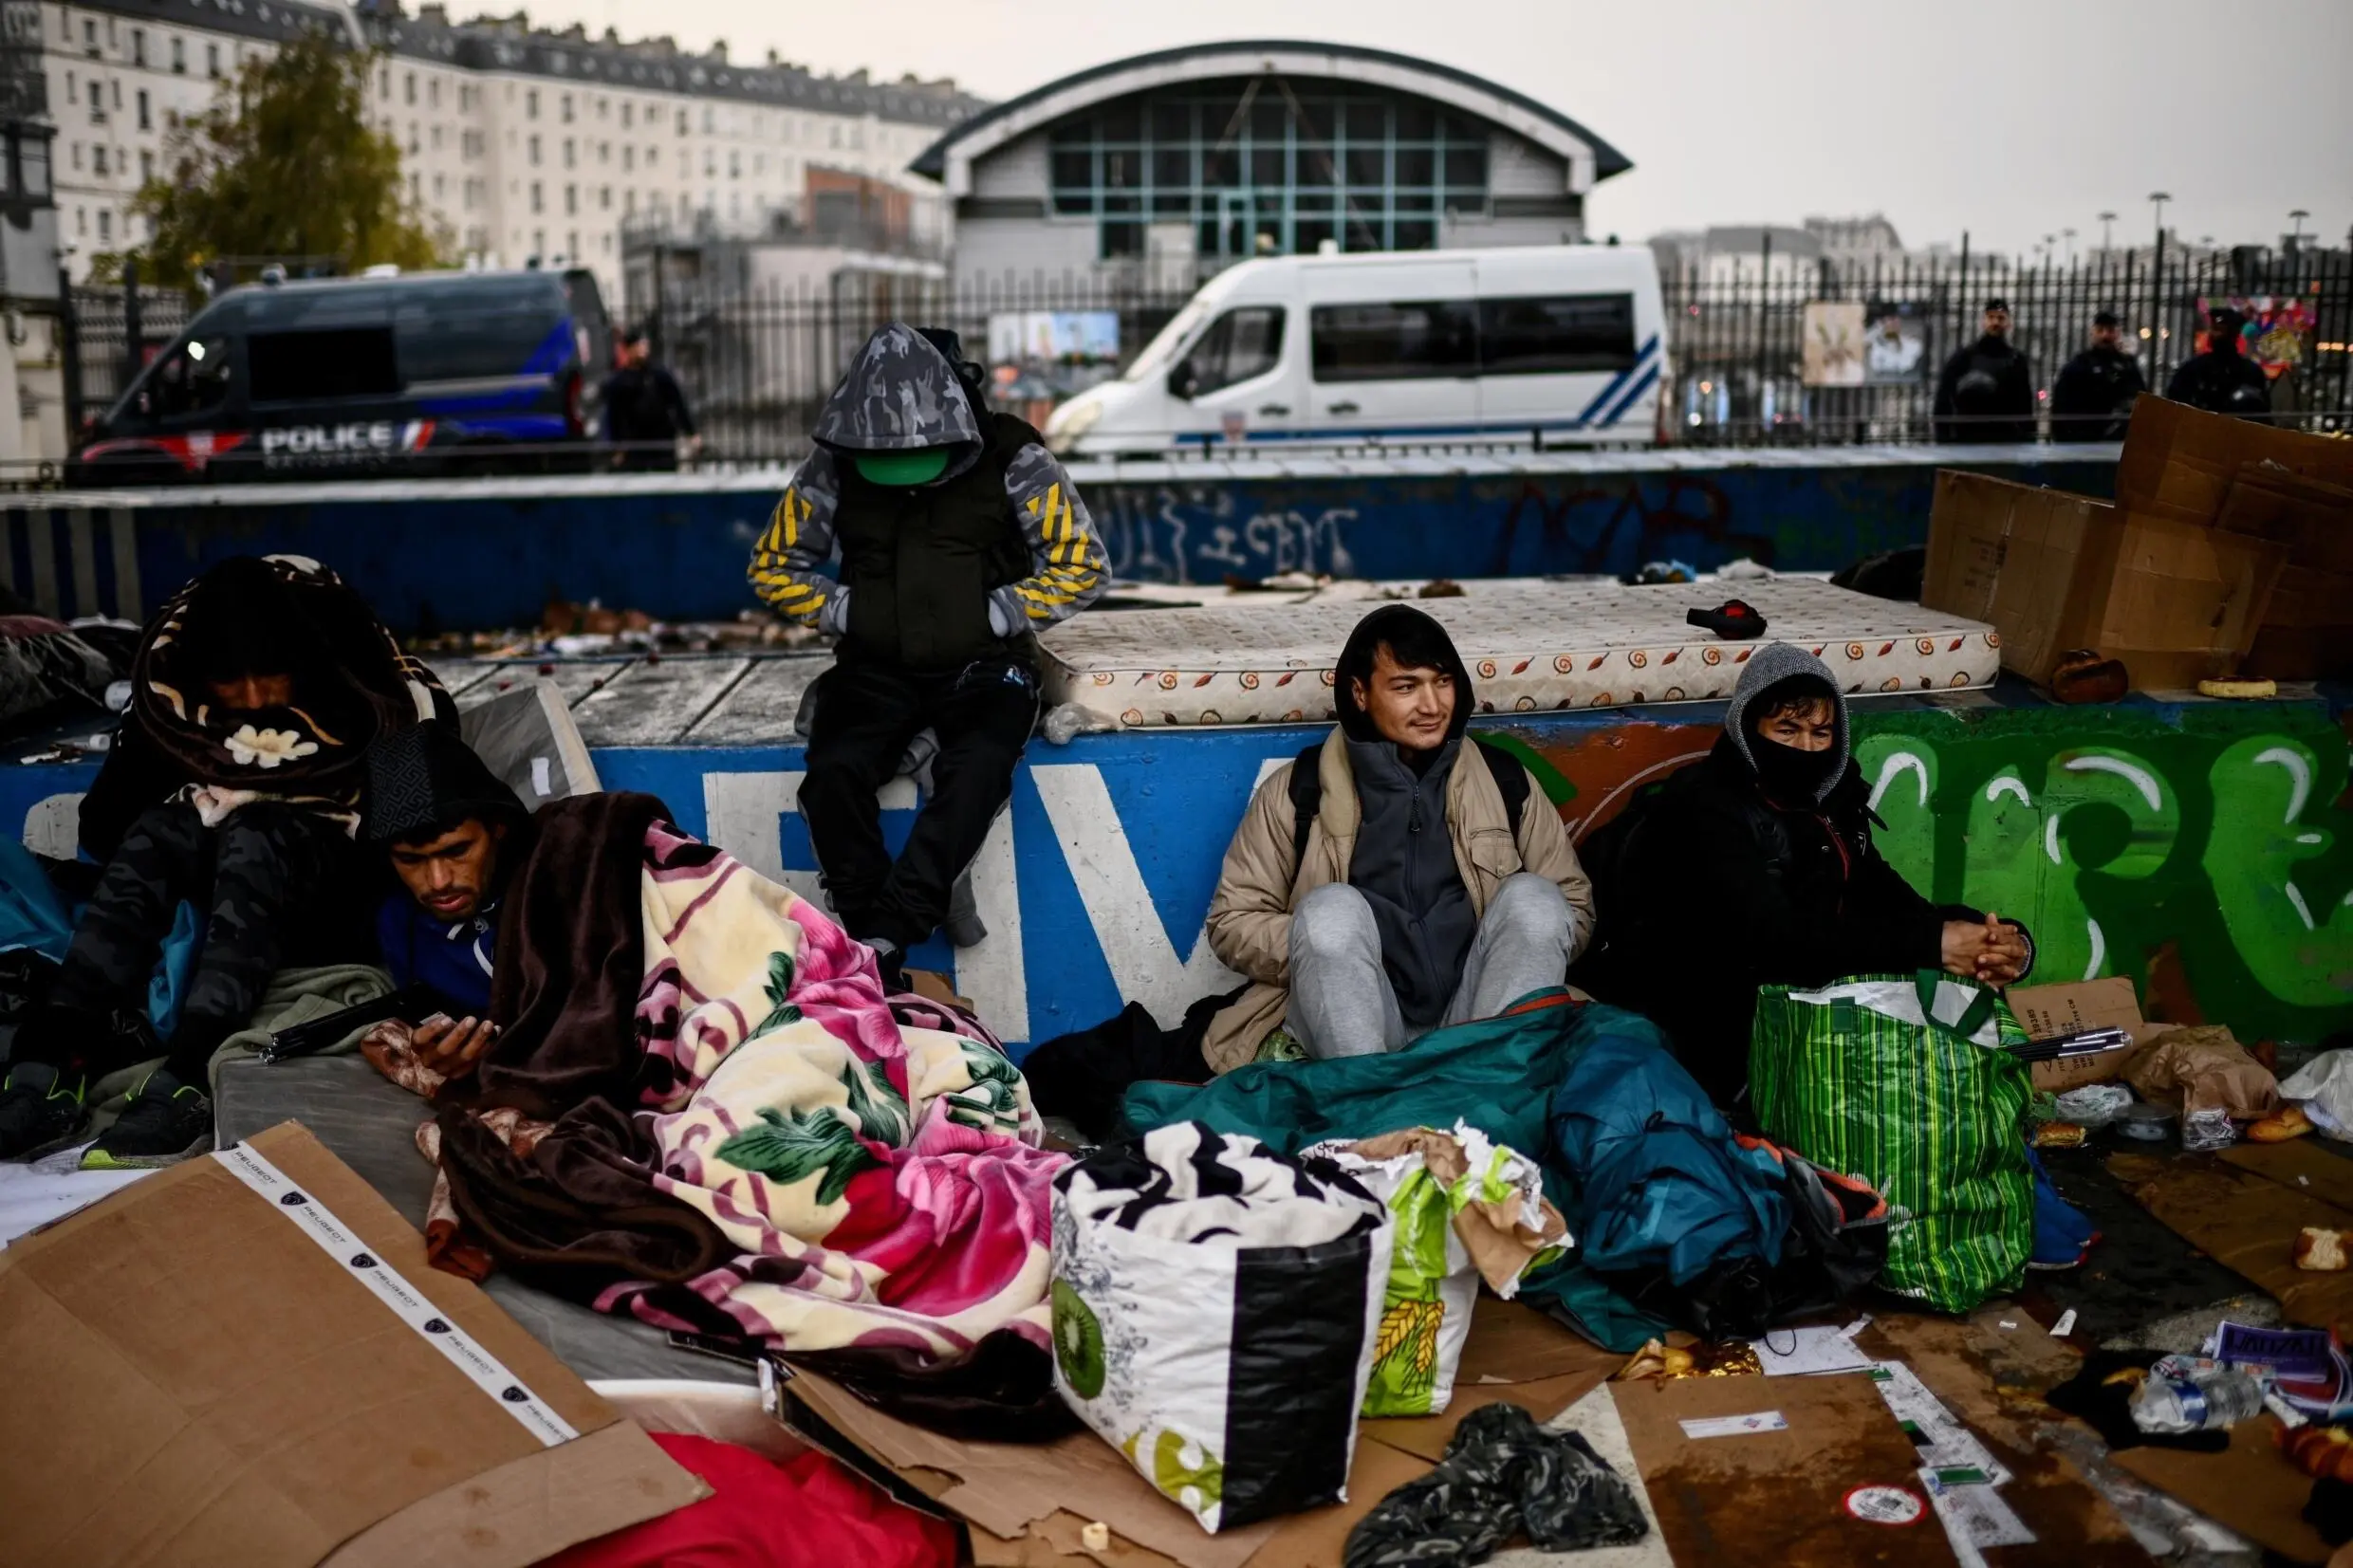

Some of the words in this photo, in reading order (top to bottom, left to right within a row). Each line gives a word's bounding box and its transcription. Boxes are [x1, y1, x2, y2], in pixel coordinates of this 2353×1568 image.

[260, 420, 394, 455] POLICE
[235, 1152, 278, 1185] PEUGEOT
[304, 1206, 347, 1243] PEUGEOT
[374, 1269, 419, 1307] PEUGEOT
[527, 1404, 570, 1442] PEUGEO
